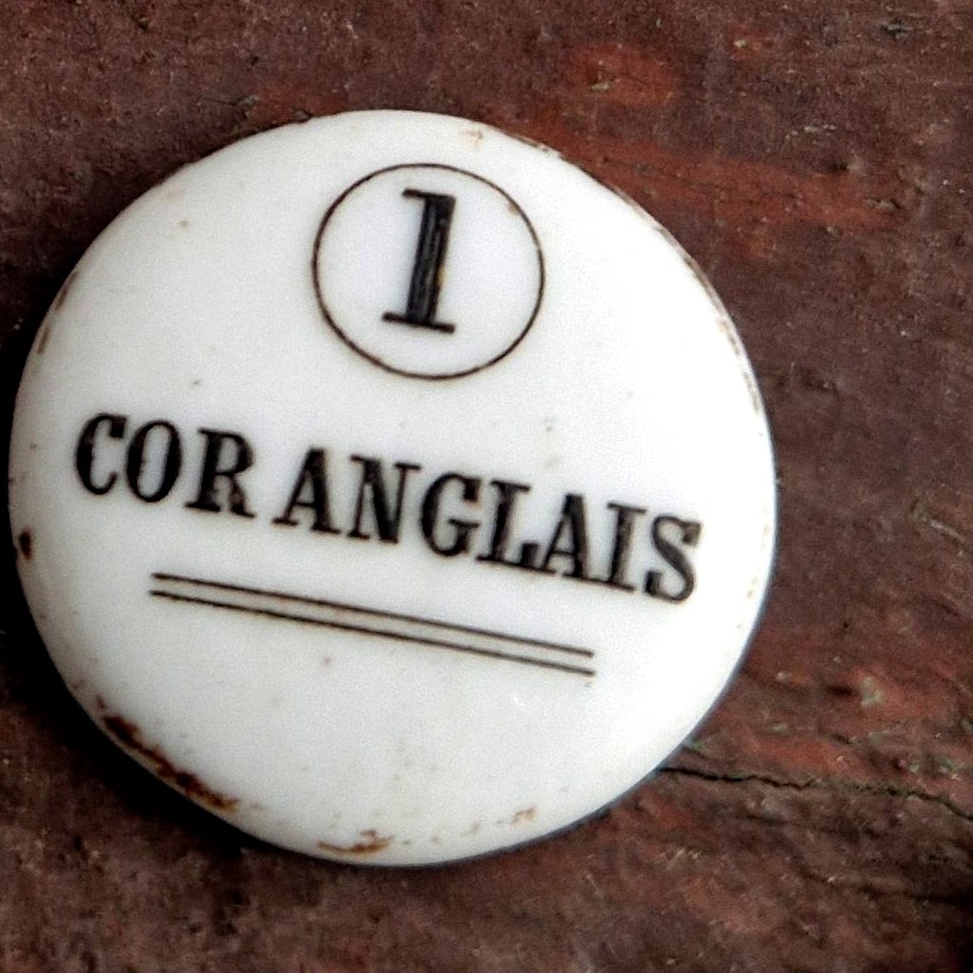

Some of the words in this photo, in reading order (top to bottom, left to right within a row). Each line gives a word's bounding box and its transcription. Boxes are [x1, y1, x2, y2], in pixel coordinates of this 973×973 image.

[362, 187, 457, 335] 1
[73, 412, 256, 520] COR
[273, 447, 703, 604] ANGLAIS
